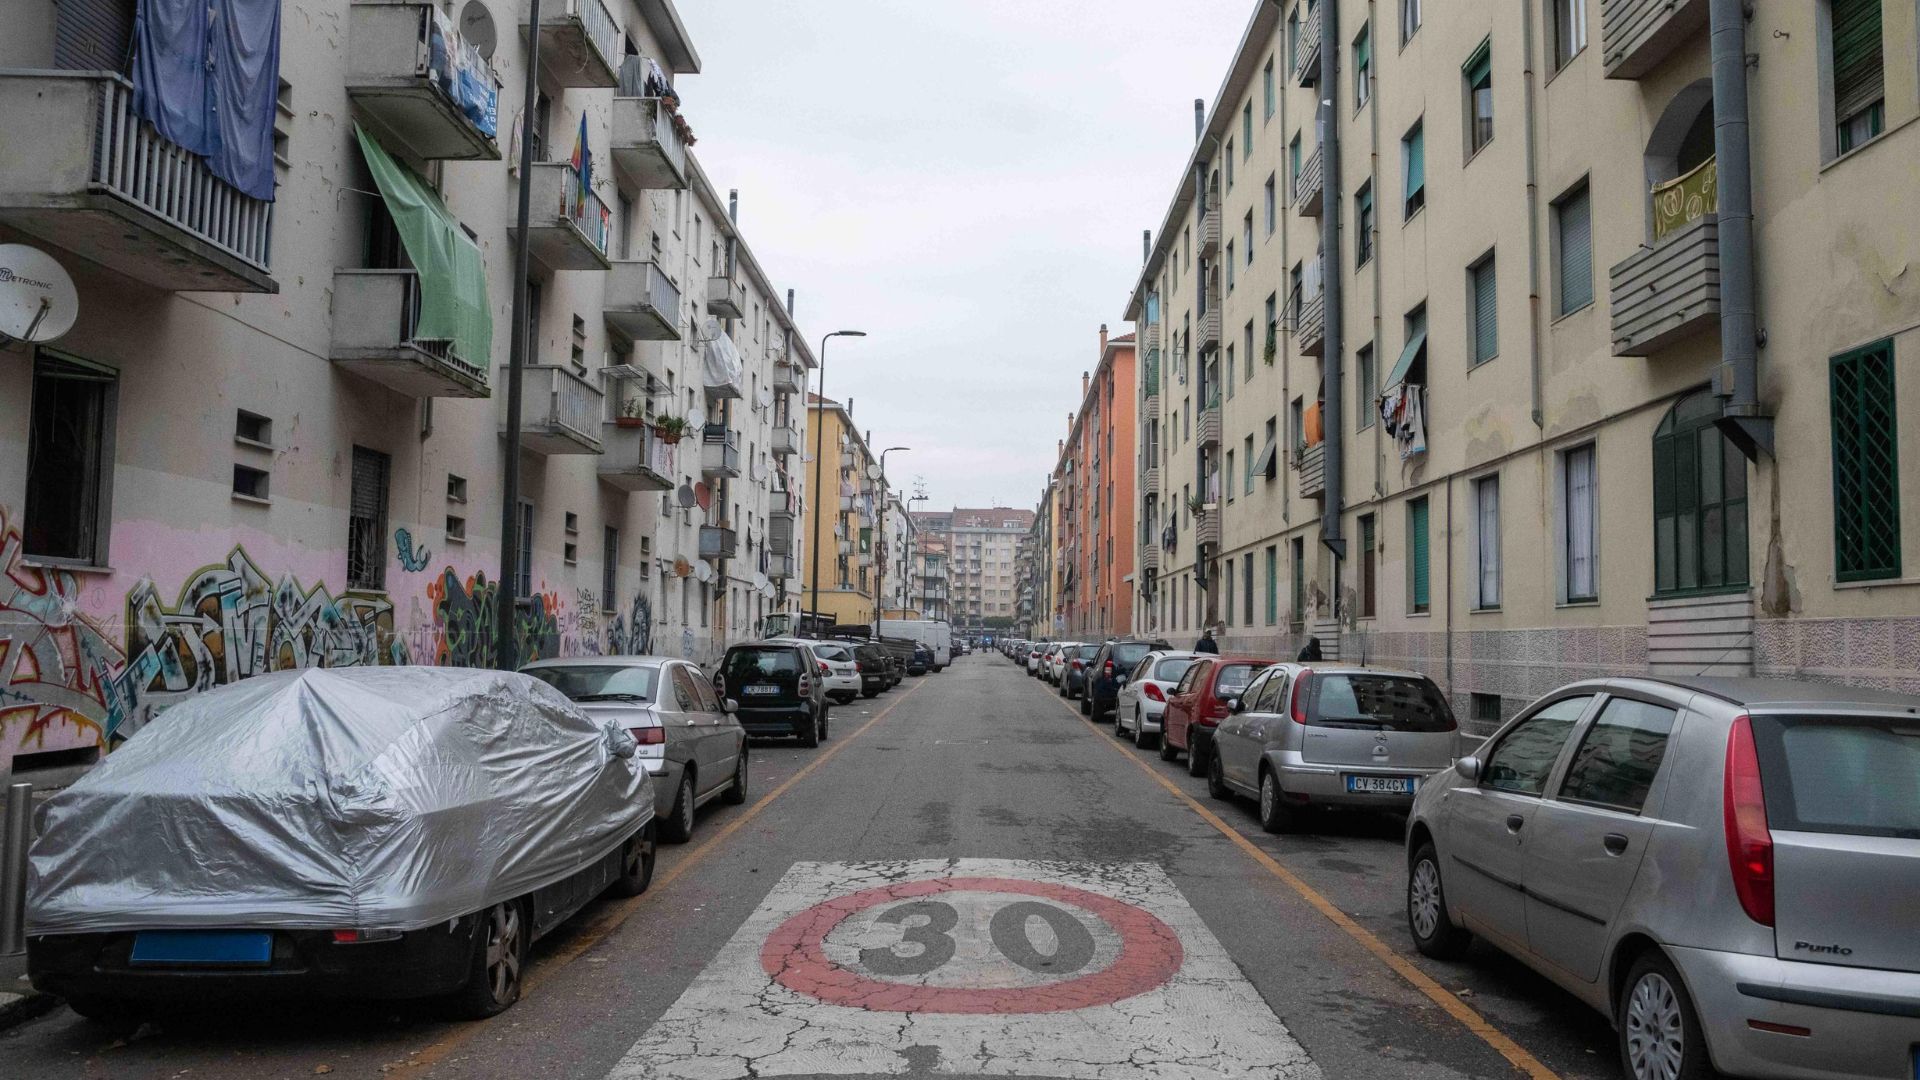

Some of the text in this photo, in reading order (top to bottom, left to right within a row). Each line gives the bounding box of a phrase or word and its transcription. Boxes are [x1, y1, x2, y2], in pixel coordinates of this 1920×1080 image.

[1355, 778, 1406, 791] CV 384GX
[859, 900, 1096, 976] 30
[1794, 940, 1853, 956] Punto
